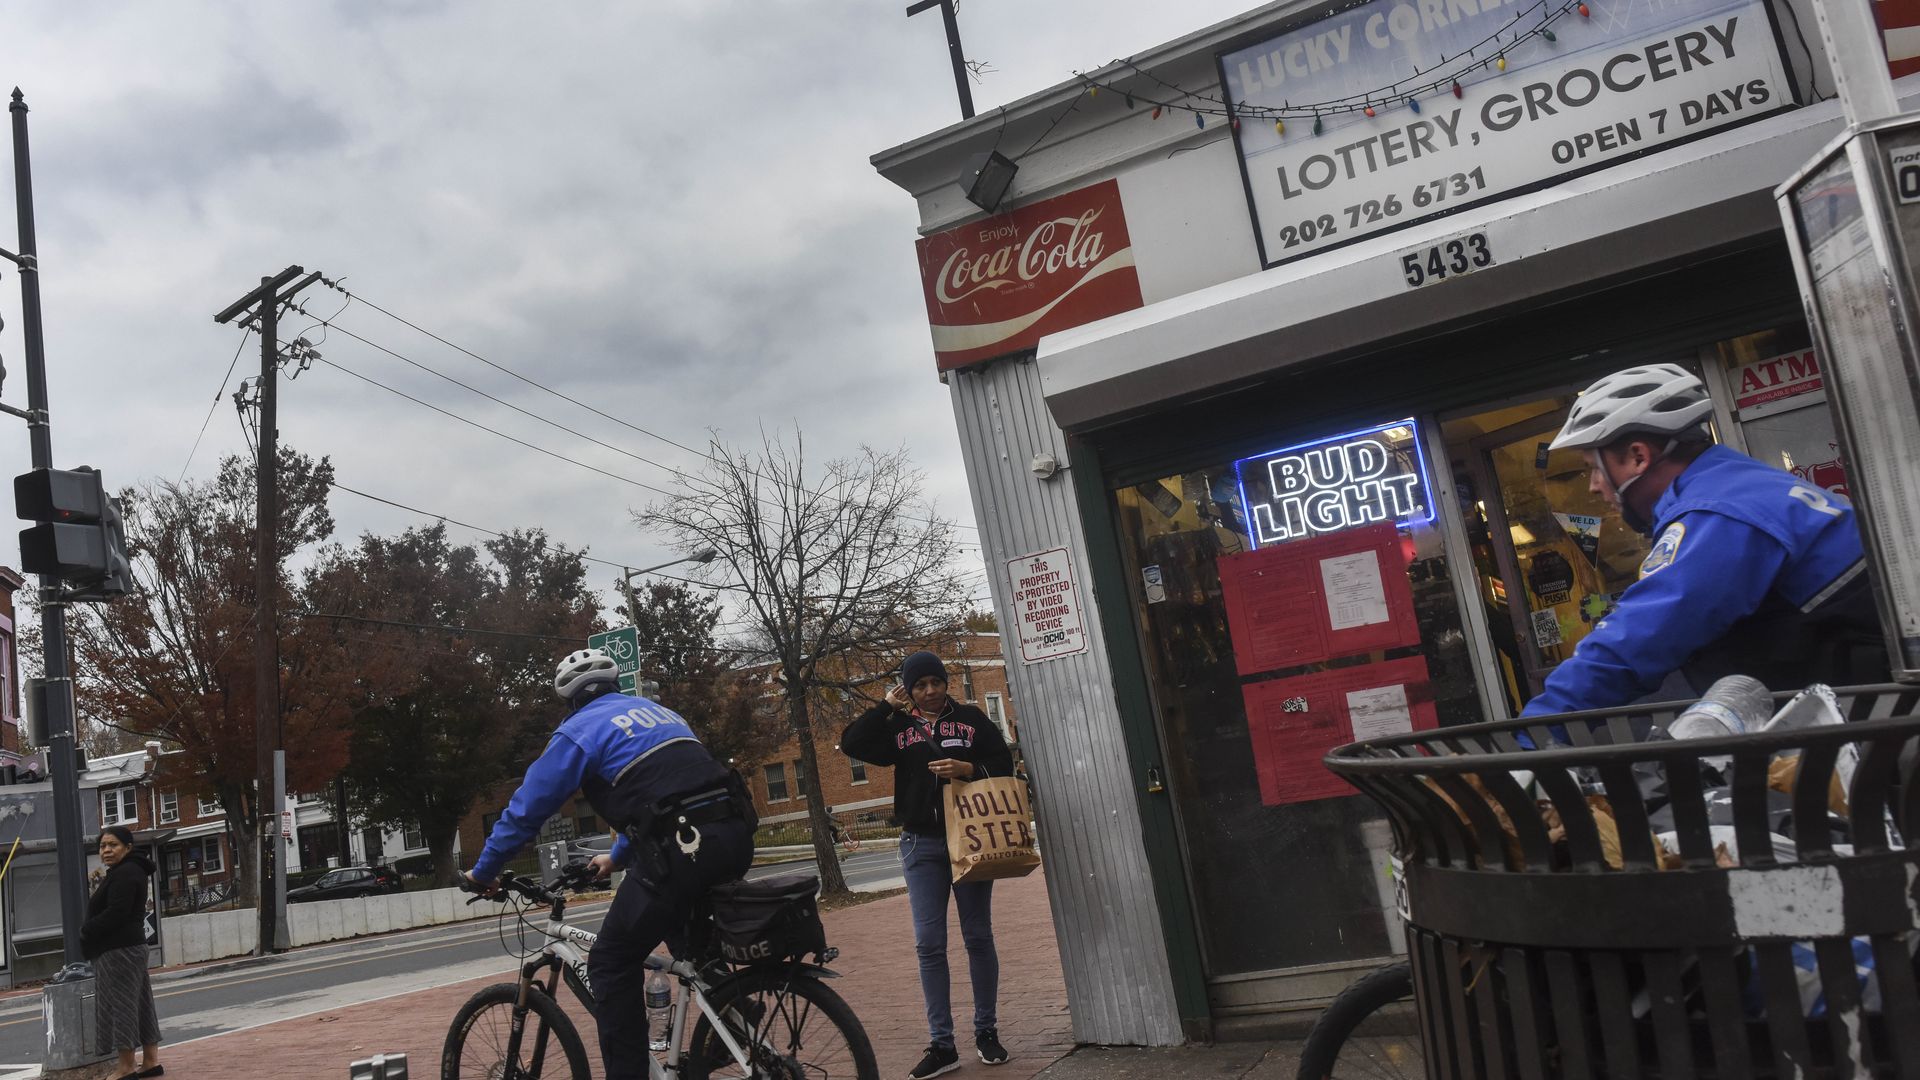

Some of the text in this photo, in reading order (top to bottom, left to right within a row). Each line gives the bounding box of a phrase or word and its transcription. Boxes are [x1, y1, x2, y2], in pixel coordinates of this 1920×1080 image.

[1239, 24, 1351, 97] LUCKY
[1551, 79, 1770, 164] OPEN 7 DAYS
[1279, 165, 1486, 249] 202 726 6731
[979, 225, 1017, 243] Enjoy
[1402, 232, 1492, 287] 5433
[1740, 350, 1820, 395] ATM
[1756, 382, 1813, 402] AVAILABLE INSIDE
[1268, 439, 1388, 498] BUD
[1253, 473, 1418, 543] LIGHT
[1569, 515, 1582, 524] WE
[1030, 562, 1048, 574] THIS
[1020, 571, 1060, 589] PROPERTY
[1015, 580, 1070, 601] IS PROTECTED
[1543, 591, 1567, 605] PUSH
[1026, 594, 1063, 611] BY VIDEO
[1024, 605, 1070, 623] RECORDING
[1035, 618, 1063, 633] DEVICE
[1536, 620, 1557, 635] PUSH
[618, 661, 635, 672] OUTE
[940, 721, 976, 744] CITY
[955, 790, 1024, 820] HOLLI
[965, 820, 1031, 851] STER
[569, 928, 598, 944] POLIC
[721, 940, 772, 961] POLICE
